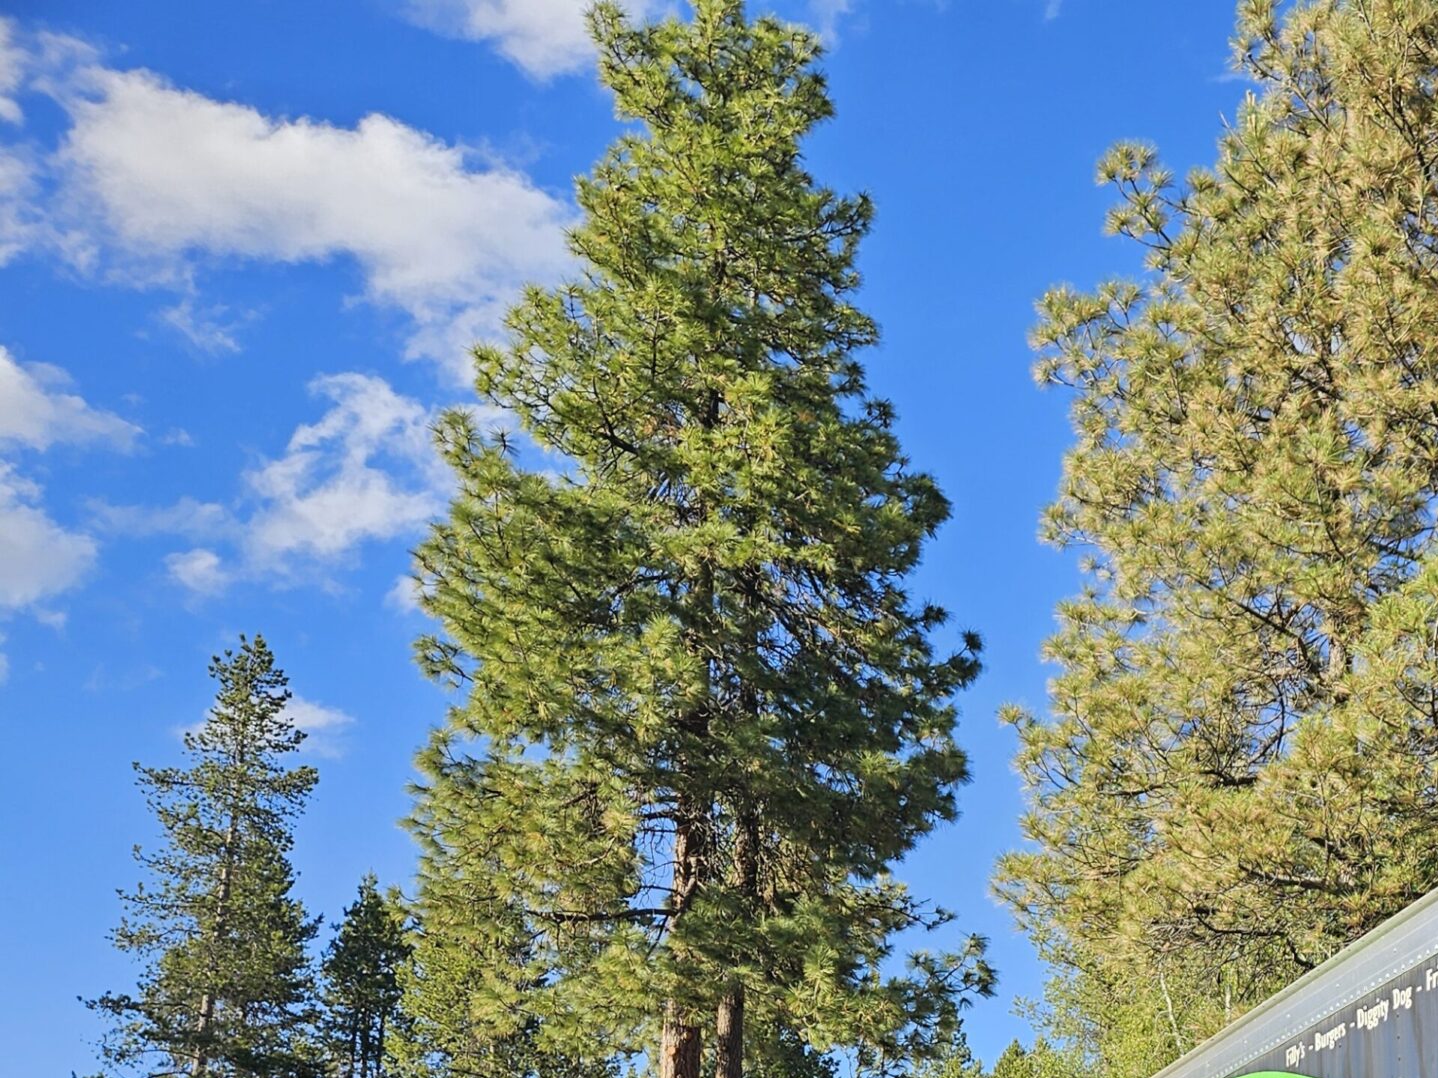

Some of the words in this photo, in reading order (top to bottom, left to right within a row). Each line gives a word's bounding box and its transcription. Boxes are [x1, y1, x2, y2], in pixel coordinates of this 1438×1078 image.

[1315, 1022, 1346, 1051] Burgers
[1357, 998, 1389, 1030] Diggity
[1393, 986, 1413, 1009] Dog
